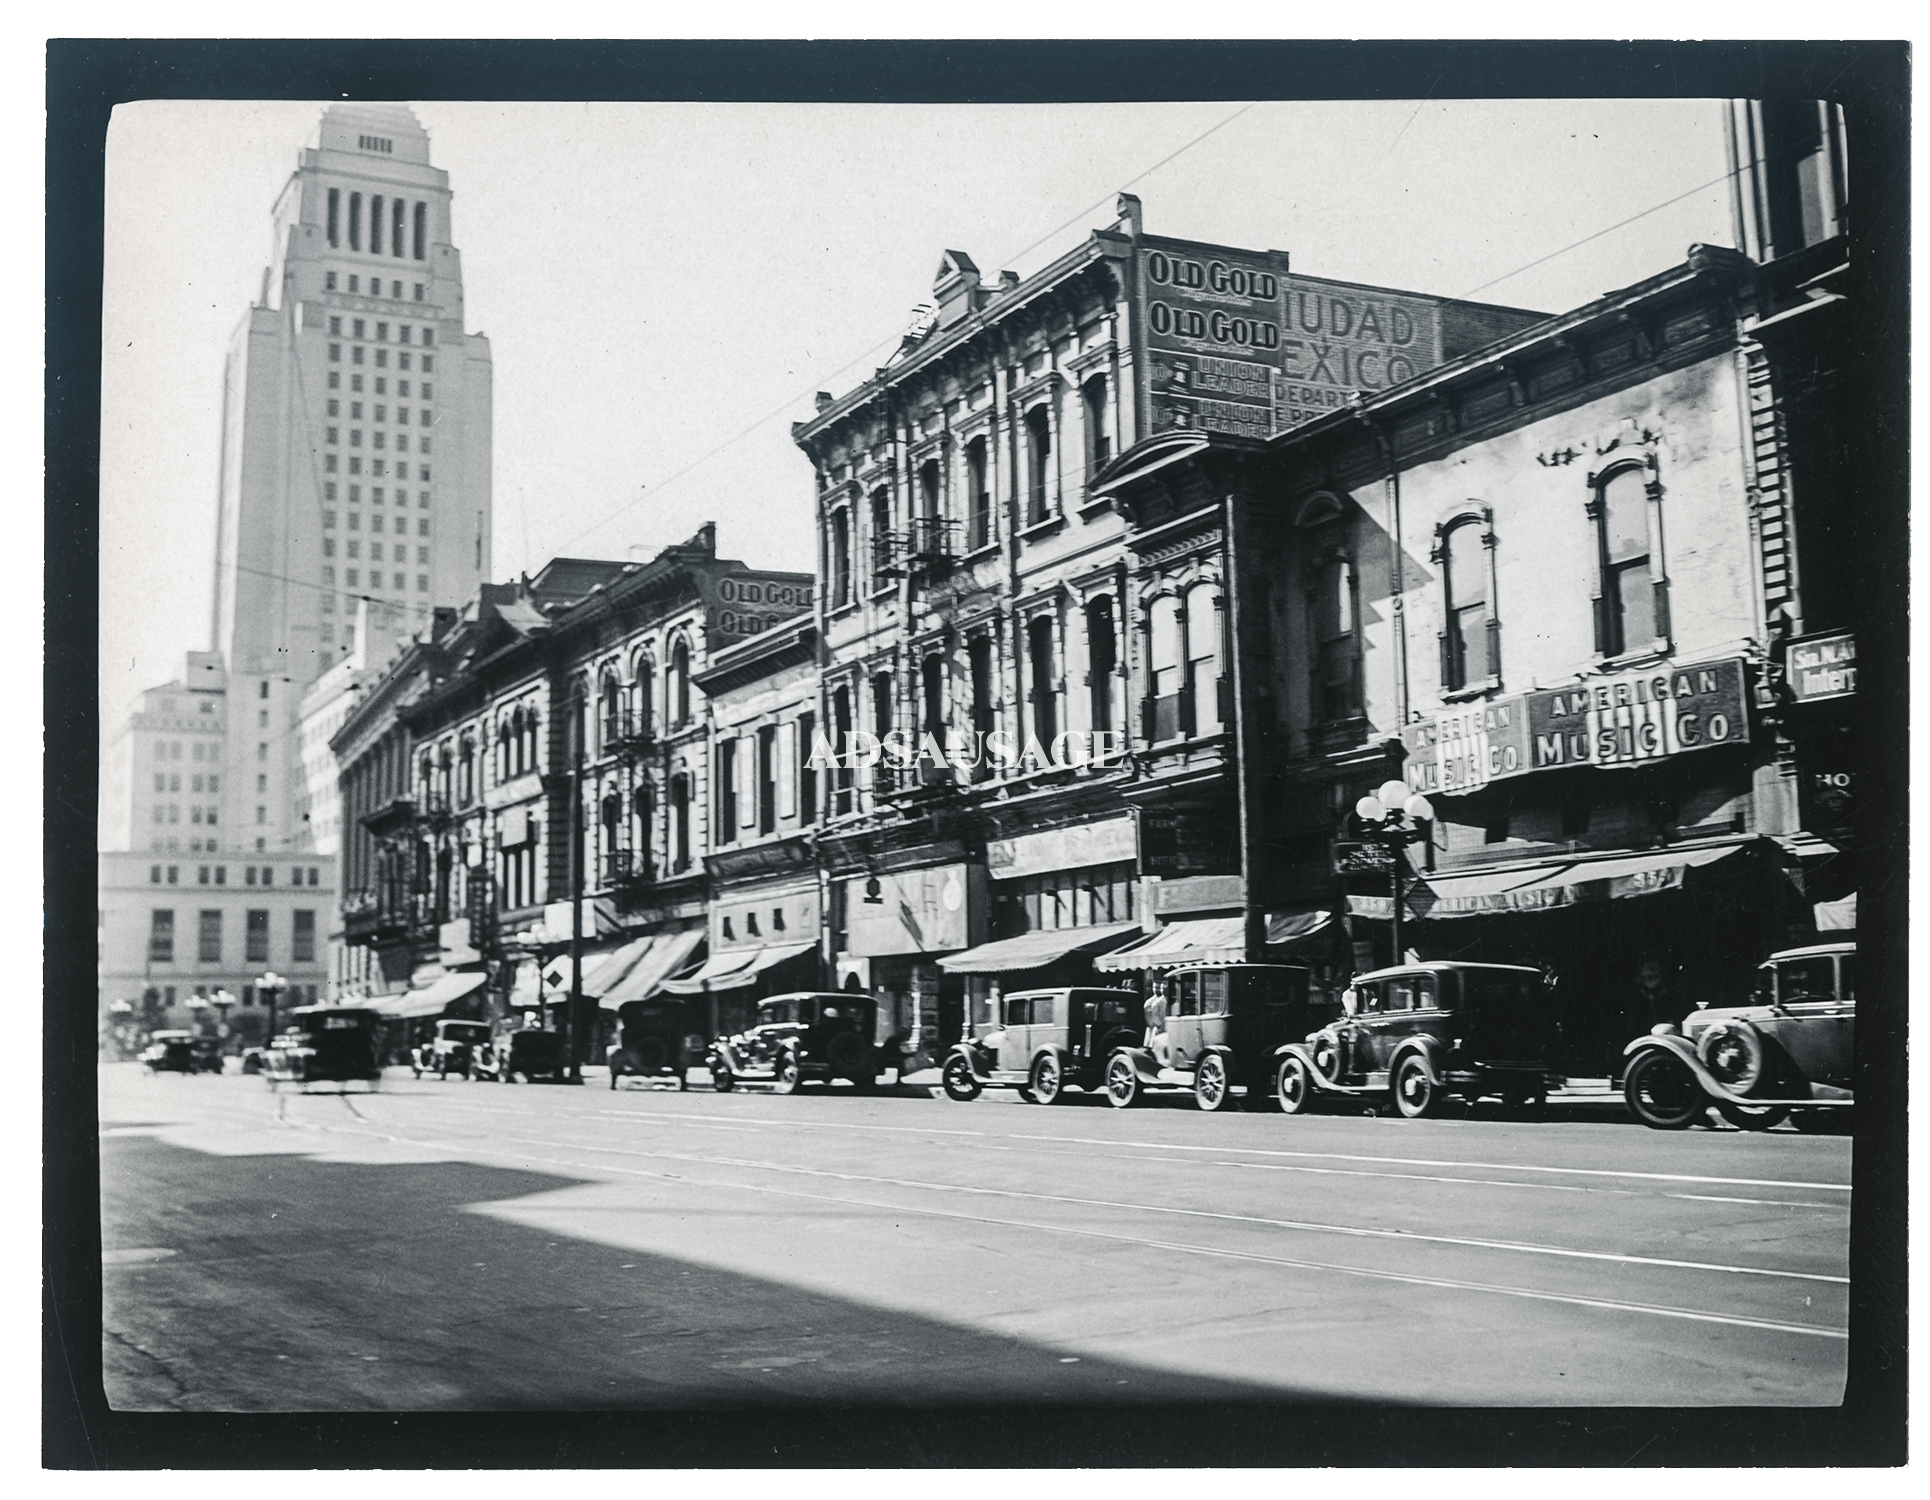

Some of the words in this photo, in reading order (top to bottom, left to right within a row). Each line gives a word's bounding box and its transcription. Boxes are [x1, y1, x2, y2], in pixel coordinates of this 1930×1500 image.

[1148, 251, 1206, 290] OLD
[1207, 261, 1279, 301] GOLD
[1149, 301, 1207, 340] OLD
[1208, 310, 1281, 350] GOLD
[1283, 290, 1414, 346] IUDAD
[1191, 371, 1270, 399] LEADER
[1198, 357, 1267, 381] UNION
[1282, 340, 1416, 390] EXICO
[719, 578, 763, 603] OLD
[719, 610, 763, 635] OLD
[1550, 669, 1719, 718] AMERICAN
[1415, 705, 1511, 750] AMERICAN
[1536, 722, 1658, 767] MUSIC
[1407, 753, 1481, 795] MUSIC
